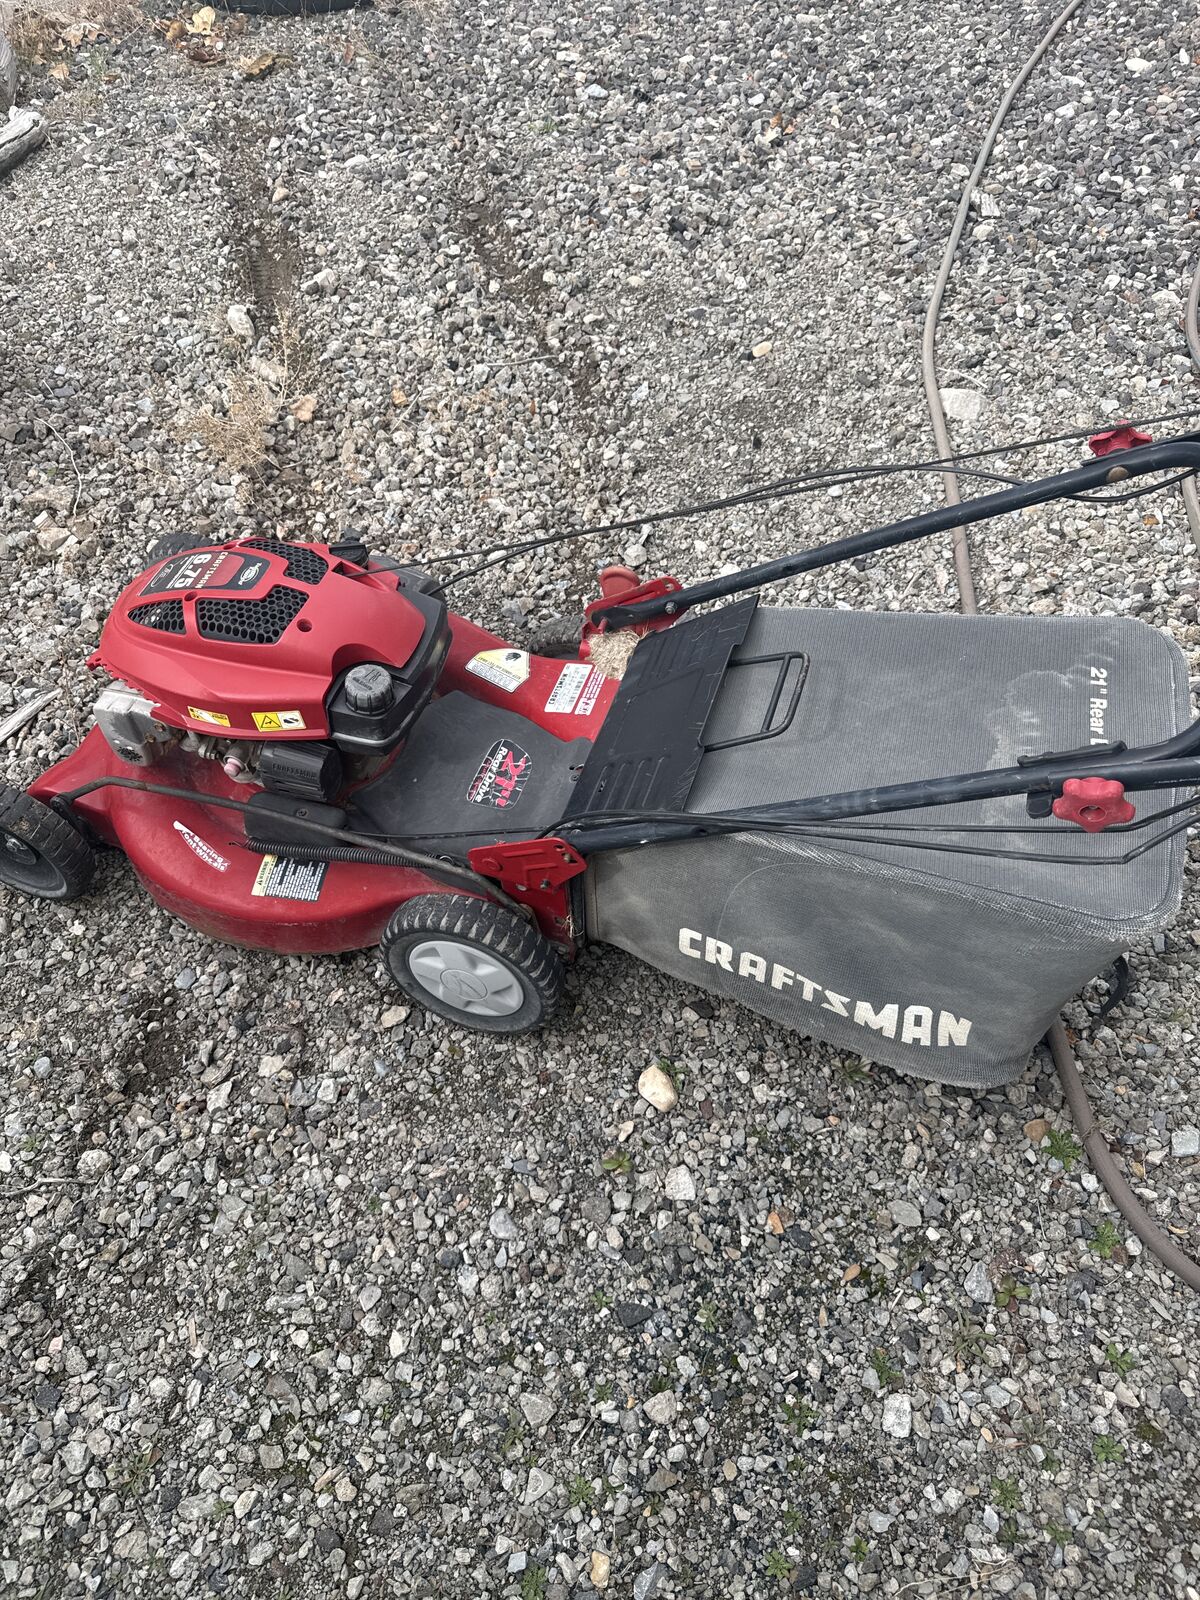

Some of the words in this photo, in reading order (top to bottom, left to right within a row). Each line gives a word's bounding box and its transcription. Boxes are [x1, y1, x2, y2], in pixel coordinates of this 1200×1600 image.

[174, 554, 212, 588] 6.75
[195, 552, 228, 589] CRAFTSMAN
[548, 673, 568, 704] CRAFTSMAN
[1090, 666, 1108, 695] 21"
[1090, 697, 1108, 735] Rear
[492, 746, 508, 773] Rear
[474, 771, 497, 803] Drive
[193, 834, 225, 863] Bearing
[678, 927, 973, 1047] CRAFTSMAN
